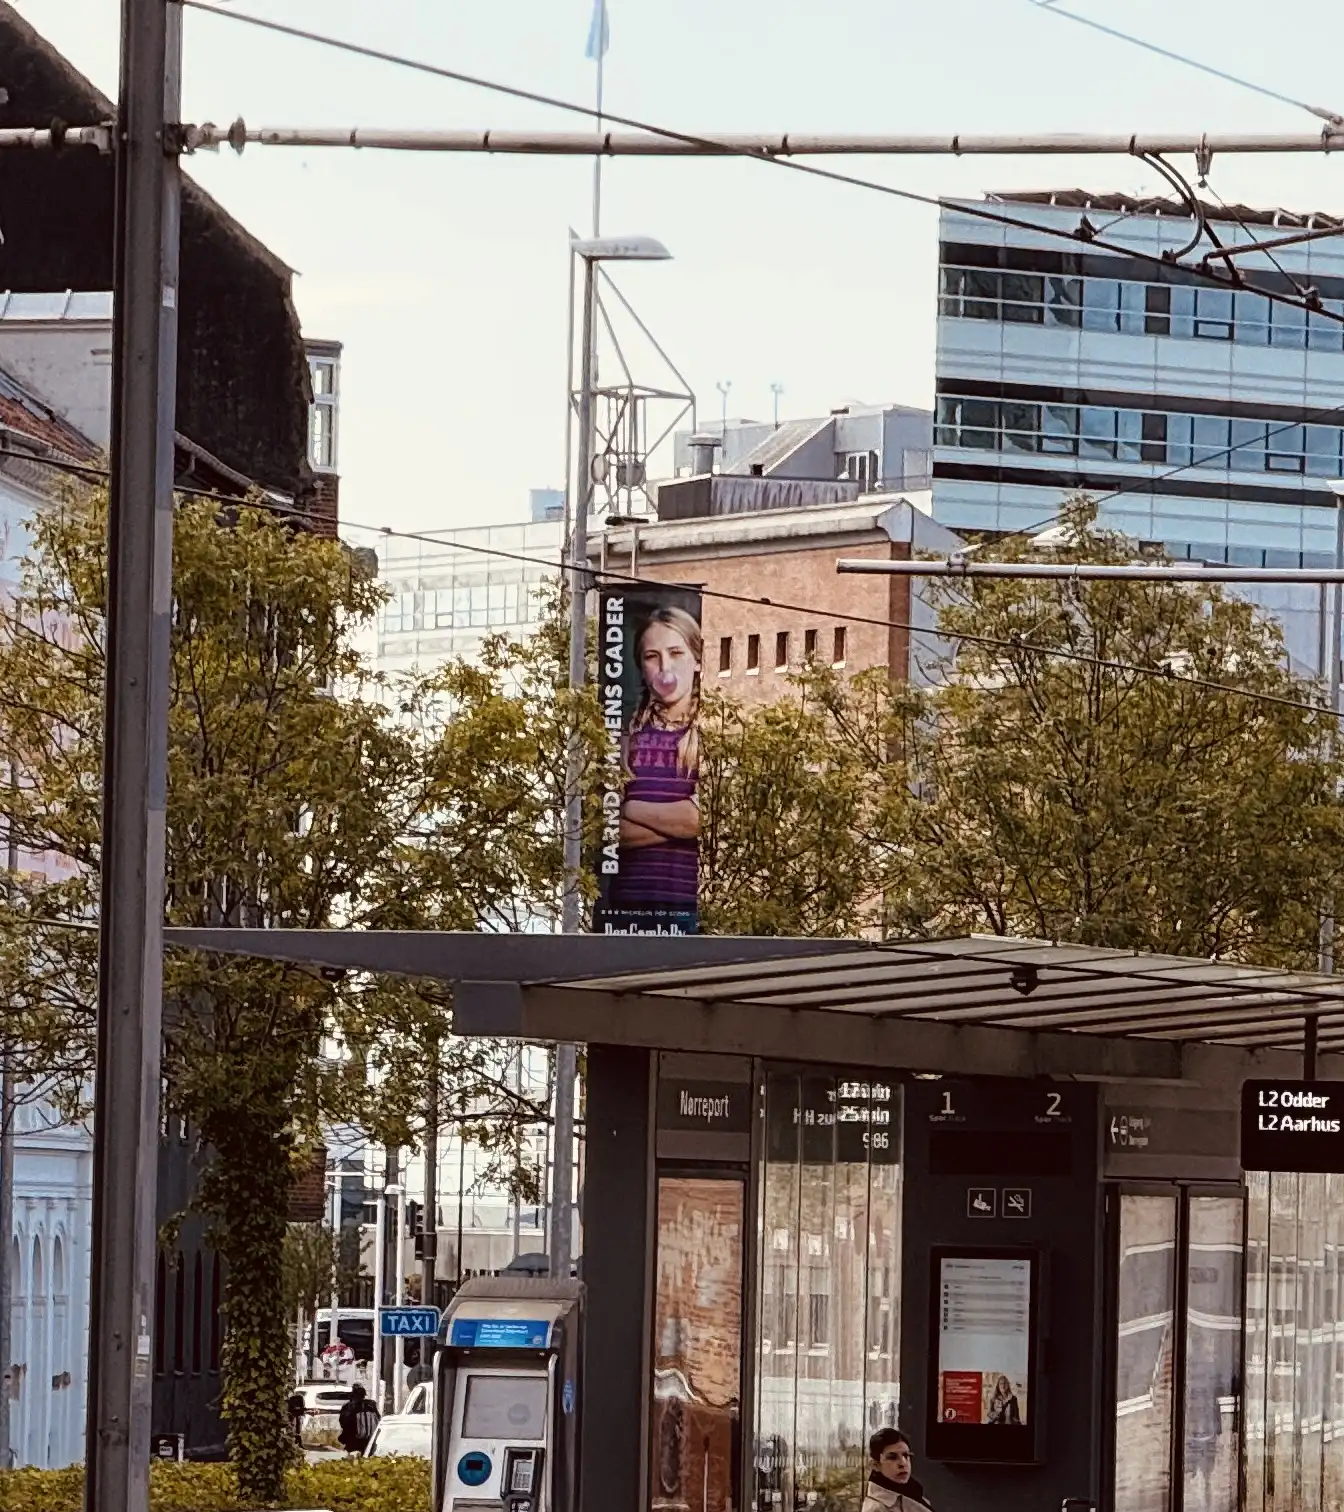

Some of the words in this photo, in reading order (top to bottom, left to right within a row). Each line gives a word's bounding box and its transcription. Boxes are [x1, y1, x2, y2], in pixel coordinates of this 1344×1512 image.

[605, 596, 625, 680] GADER
[941, 1091, 956, 1115] 1
[1046, 1092, 1062, 1116] 2
[1258, 1090, 1278, 1108] L2
[1280, 1091, 1331, 1109] Odder
[1258, 1114, 1278, 1131] L2
[1280, 1115, 1341, 1133] Aarhus
[387, 1315, 430, 1332] TAXI
